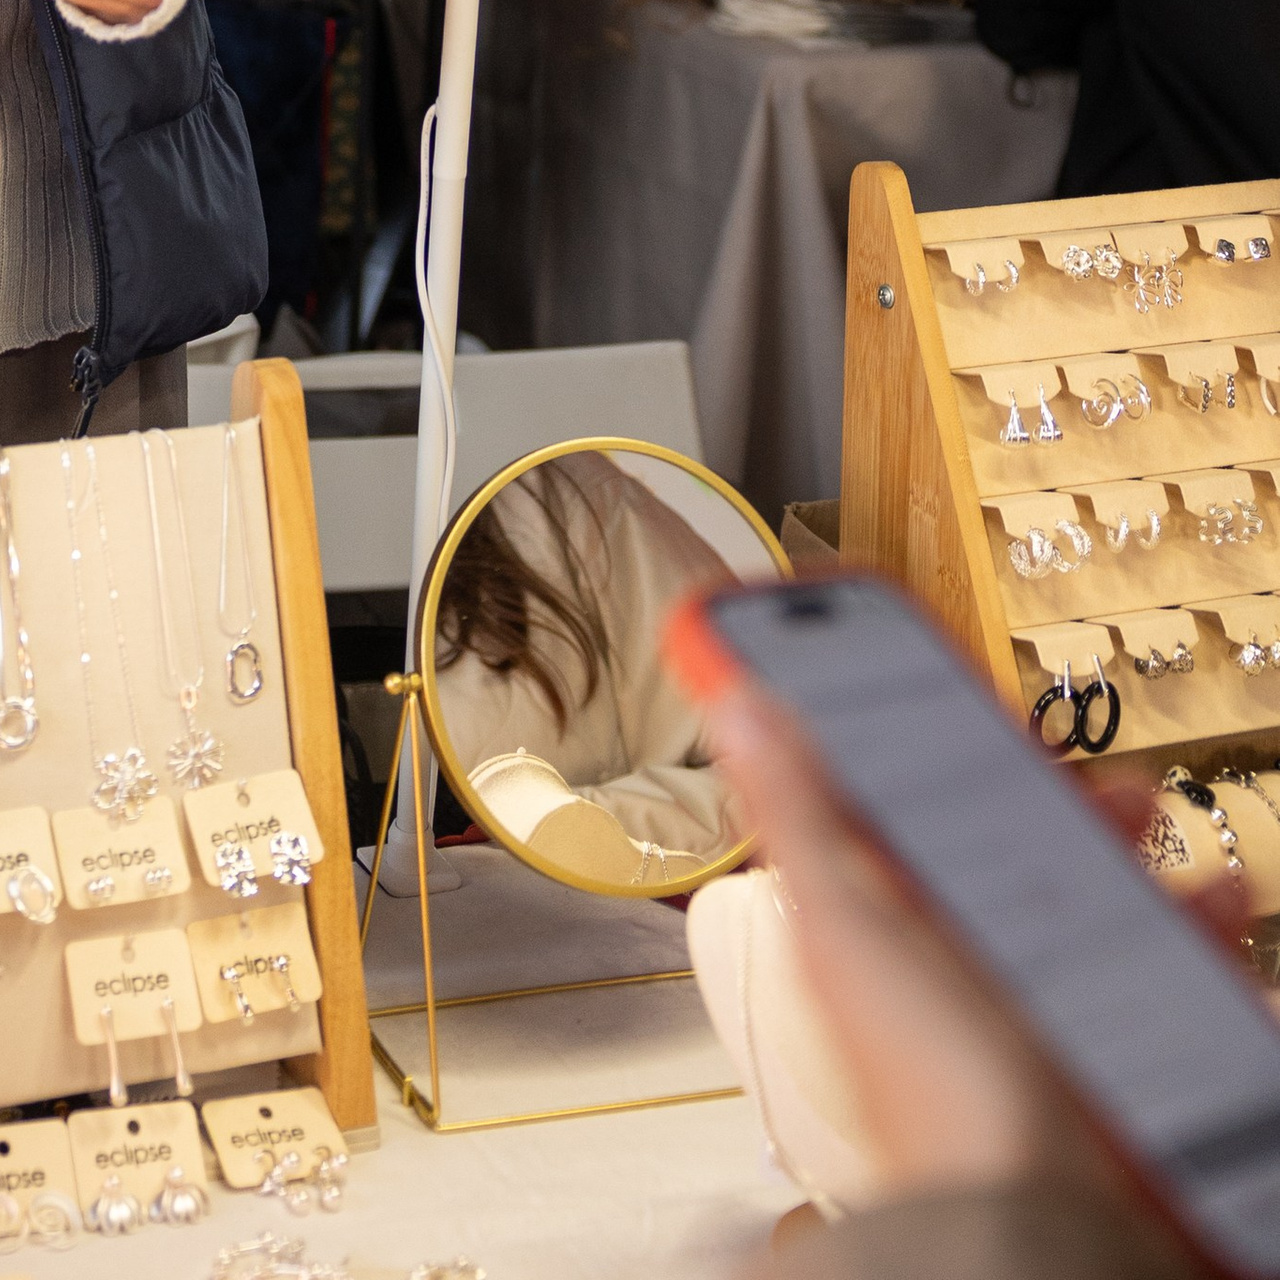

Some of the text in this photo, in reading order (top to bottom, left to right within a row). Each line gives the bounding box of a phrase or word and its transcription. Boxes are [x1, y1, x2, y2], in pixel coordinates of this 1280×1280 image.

[211, 815, 282, 847] eclipse
[82, 845, 156, 873] eclipse
[95, 970, 170, 998] eclipse
[231, 1126, 305, 1149] eclipse
[92, 1140, 172, 1169] eclipse
